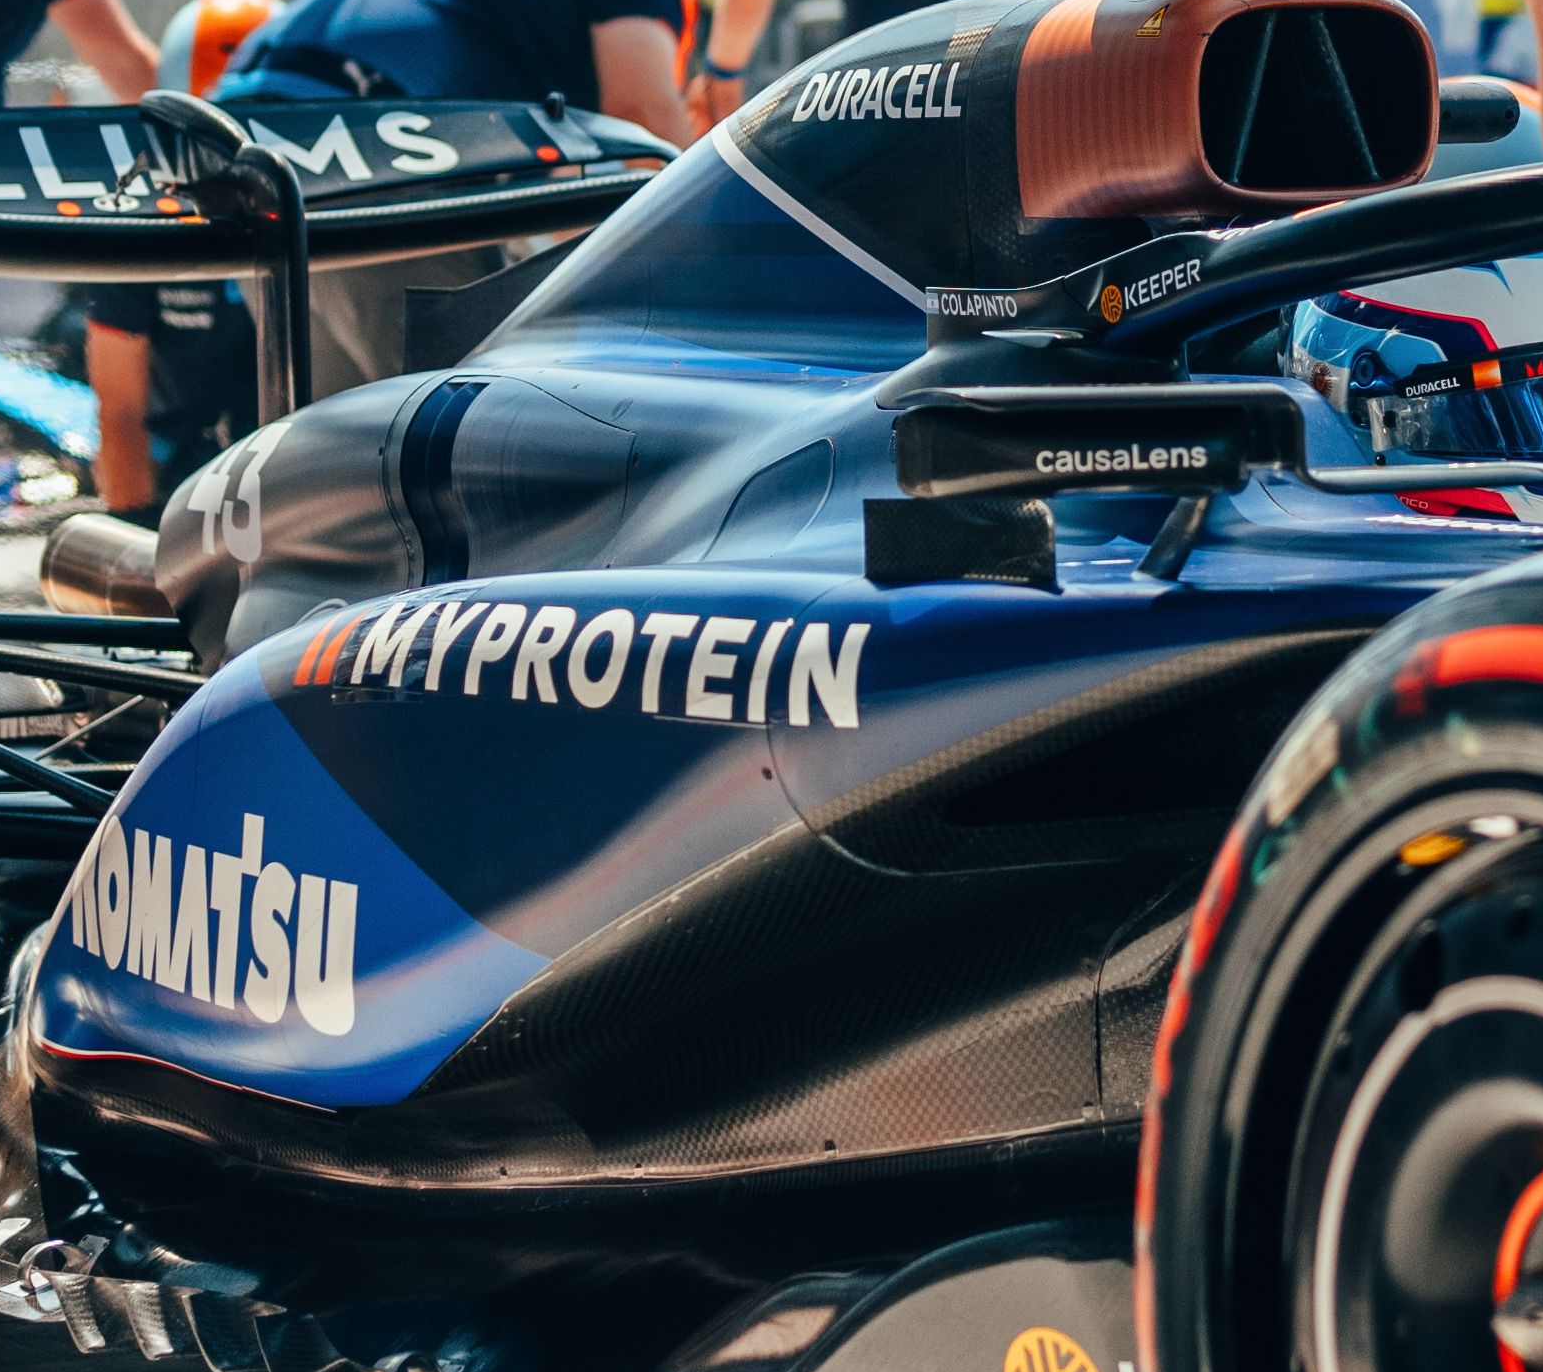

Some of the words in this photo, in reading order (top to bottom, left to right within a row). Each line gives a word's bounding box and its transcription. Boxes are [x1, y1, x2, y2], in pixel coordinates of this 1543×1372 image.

[793, 61, 962, 123] DURACELL
[941, 291, 1018, 319] COLAPINTO
[1124, 258, 1202, 310] KEEPER
[1405, 376, 1461, 398] DURACELL
[1036, 443, 1208, 475] causaLens
[187, 421, 293, 563] 43
[351, 601, 869, 729] MYPROTEIN
[71, 812, 359, 1036] KOMATSU
